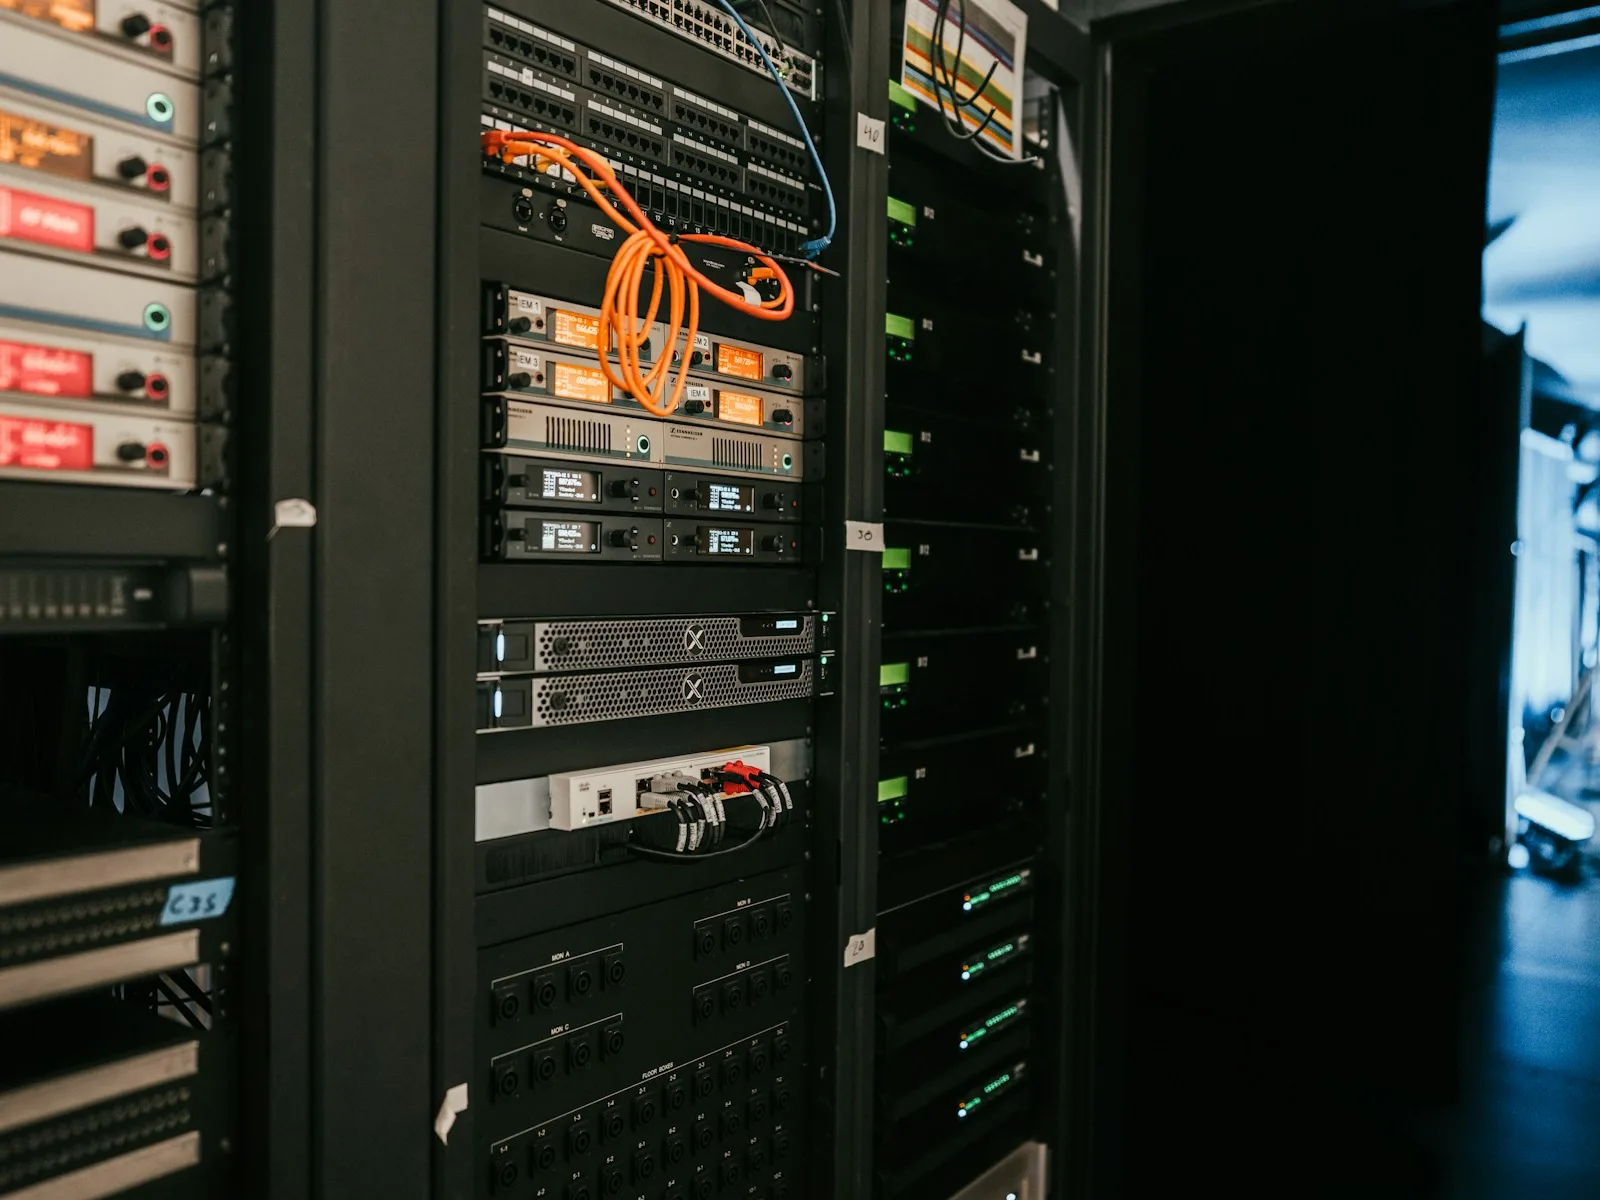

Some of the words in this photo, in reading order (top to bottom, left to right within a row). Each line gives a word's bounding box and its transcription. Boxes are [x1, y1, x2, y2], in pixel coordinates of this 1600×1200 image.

[864, 124, 879, 142] 40
[858, 530, 872, 540] 30
[552, 953, 564, 961] MON
[550, 1026, 562, 1035] MON
[642, 1068, 657, 1080] FLOOR
[658, 1061, 674, 1072] BOXES
